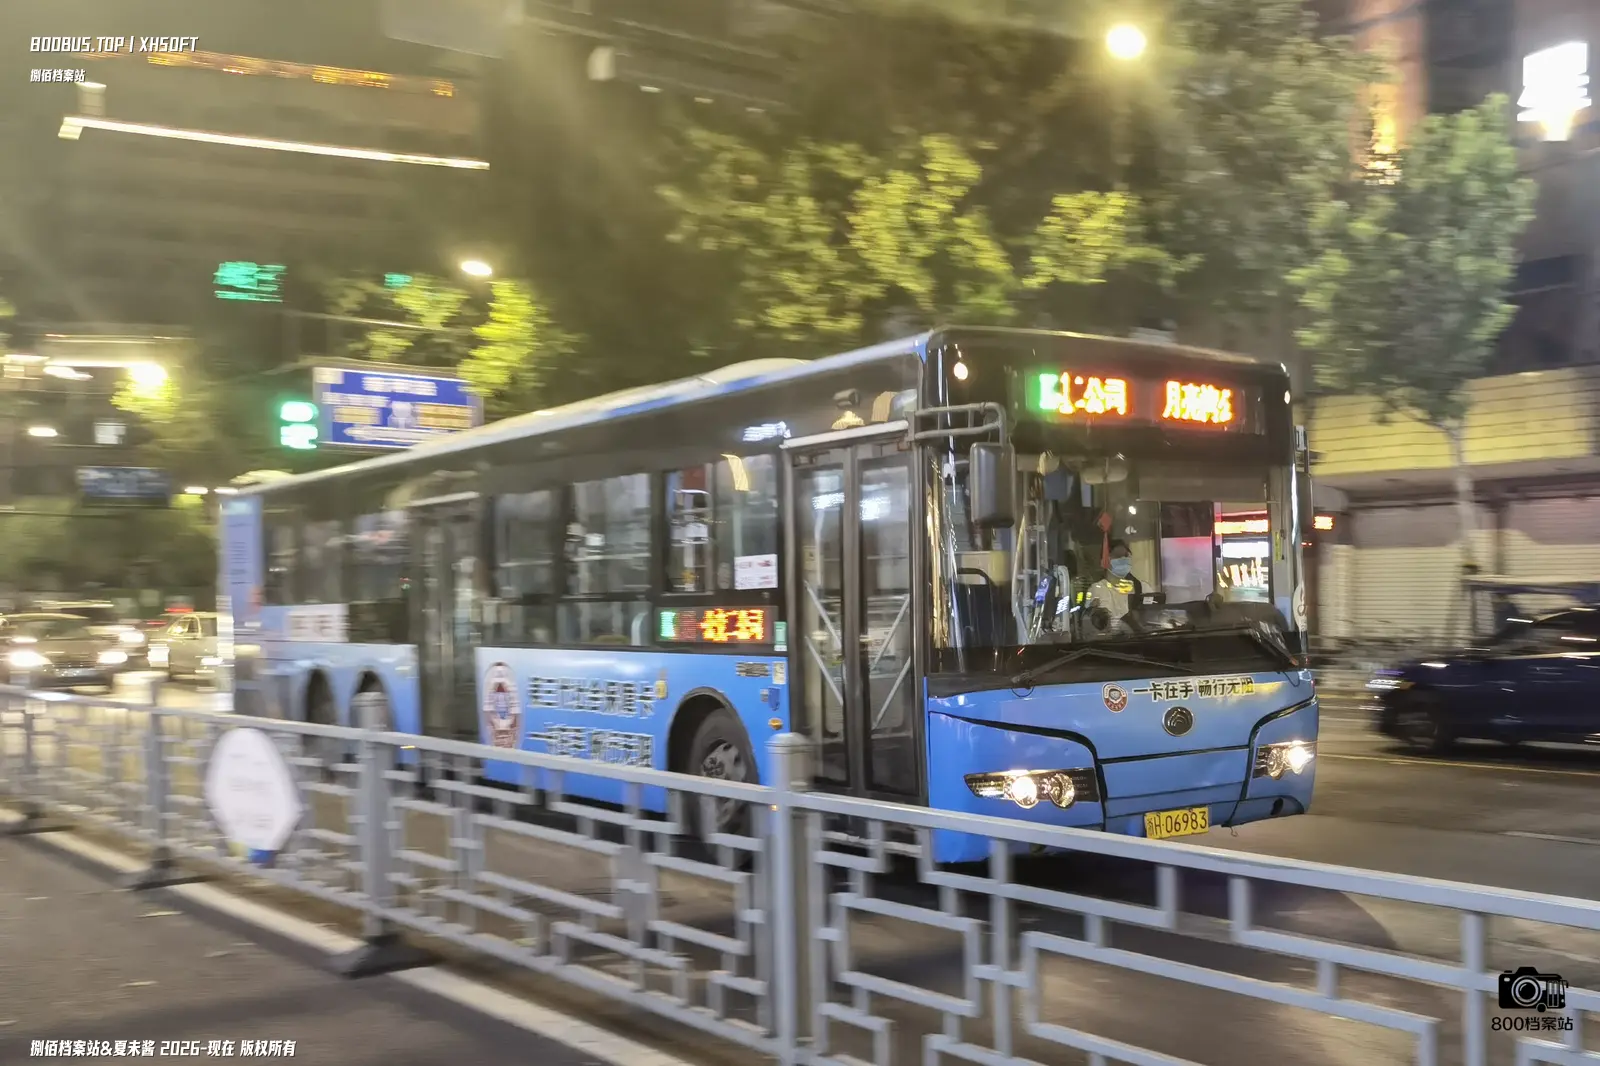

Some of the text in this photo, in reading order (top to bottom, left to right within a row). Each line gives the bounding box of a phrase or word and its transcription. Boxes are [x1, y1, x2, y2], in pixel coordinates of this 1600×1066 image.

[1133, 681, 1194, 701] 一卡在手
[1197, 677, 1255, 697] 畅行无阻
